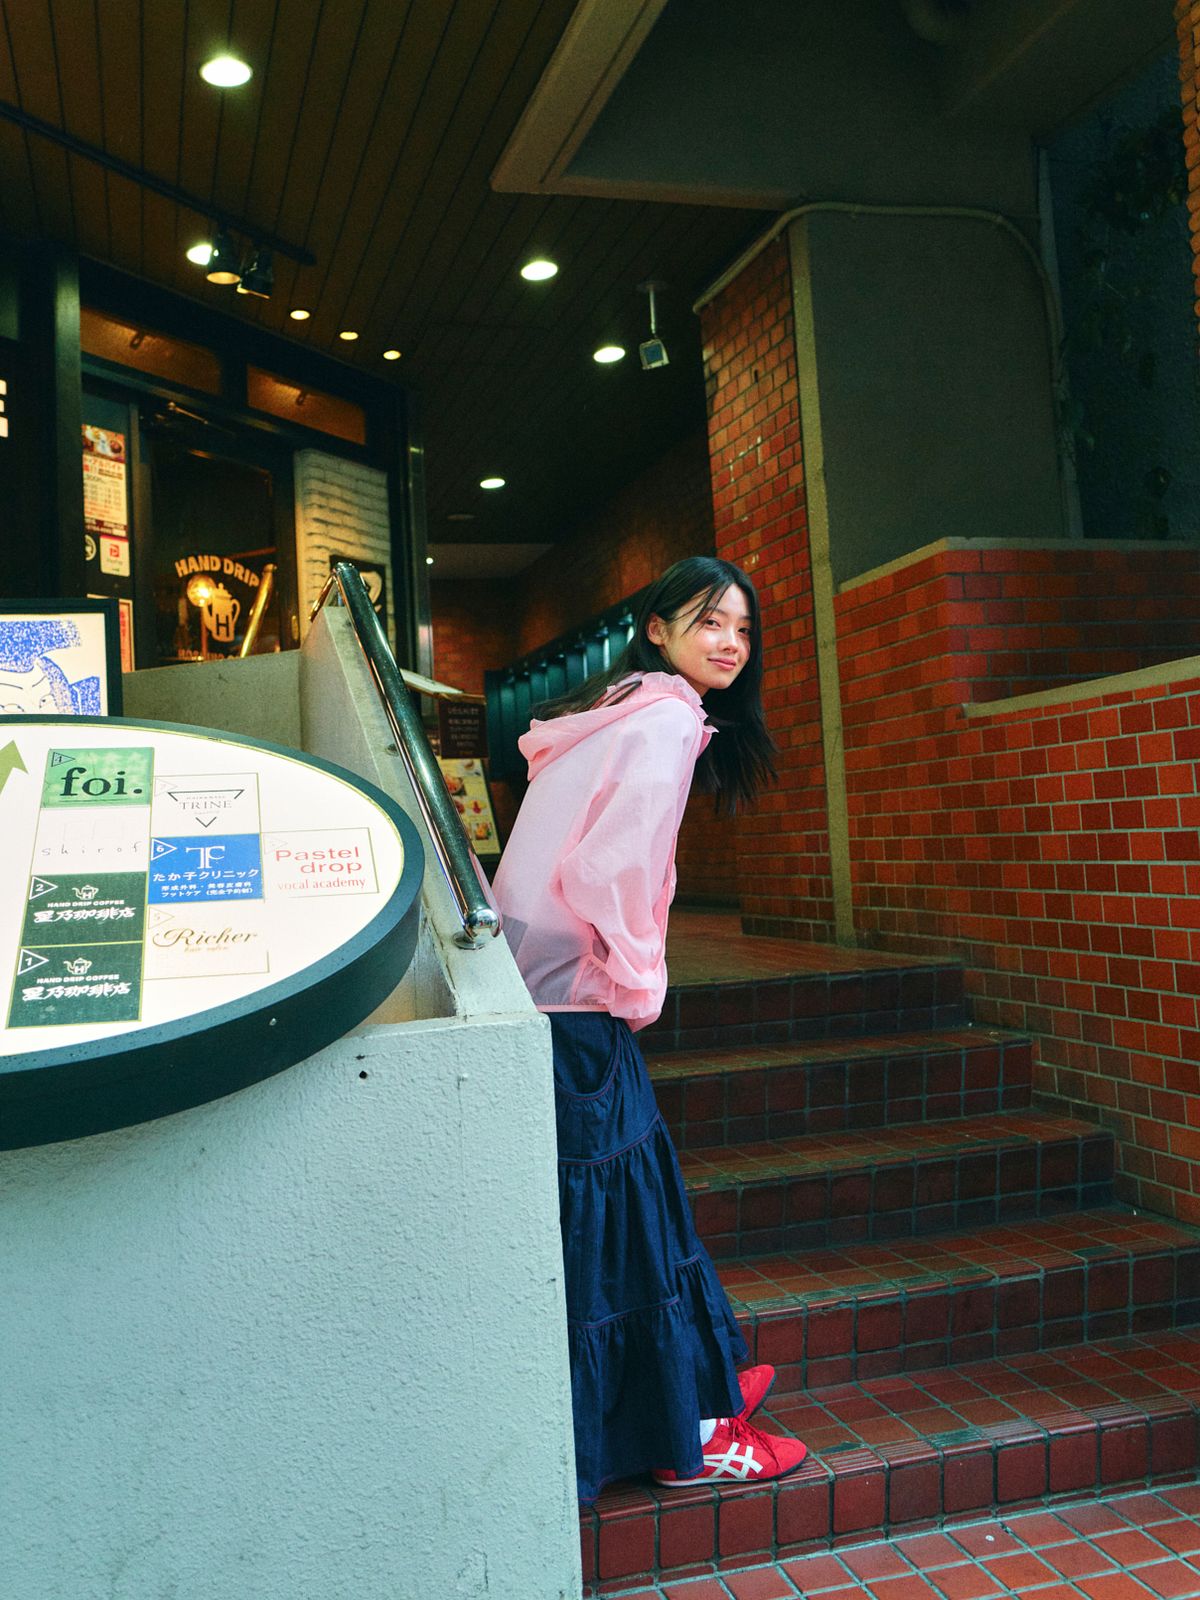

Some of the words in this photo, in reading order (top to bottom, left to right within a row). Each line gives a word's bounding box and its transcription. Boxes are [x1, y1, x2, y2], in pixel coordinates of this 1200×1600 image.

[175, 555, 221, 578] HAND
[224, 558, 260, 587] DRIP
[59, 767, 143, 797] foi.
[179, 800, 232, 810] TRINE
[156, 845, 165, 853] 6
[275, 846, 360, 862] Pastel
[300, 862, 363, 874] drop
[152, 869, 260, 882] たか子クリニック
[35, 884, 44, 892] 2
[278, 879, 309, 890] vocal
[312, 876, 367, 889] academy
[152, 927, 258, 948] Richer
[25, 957, 33, 966] 1
[63, 975, 85, 983] DRIP
